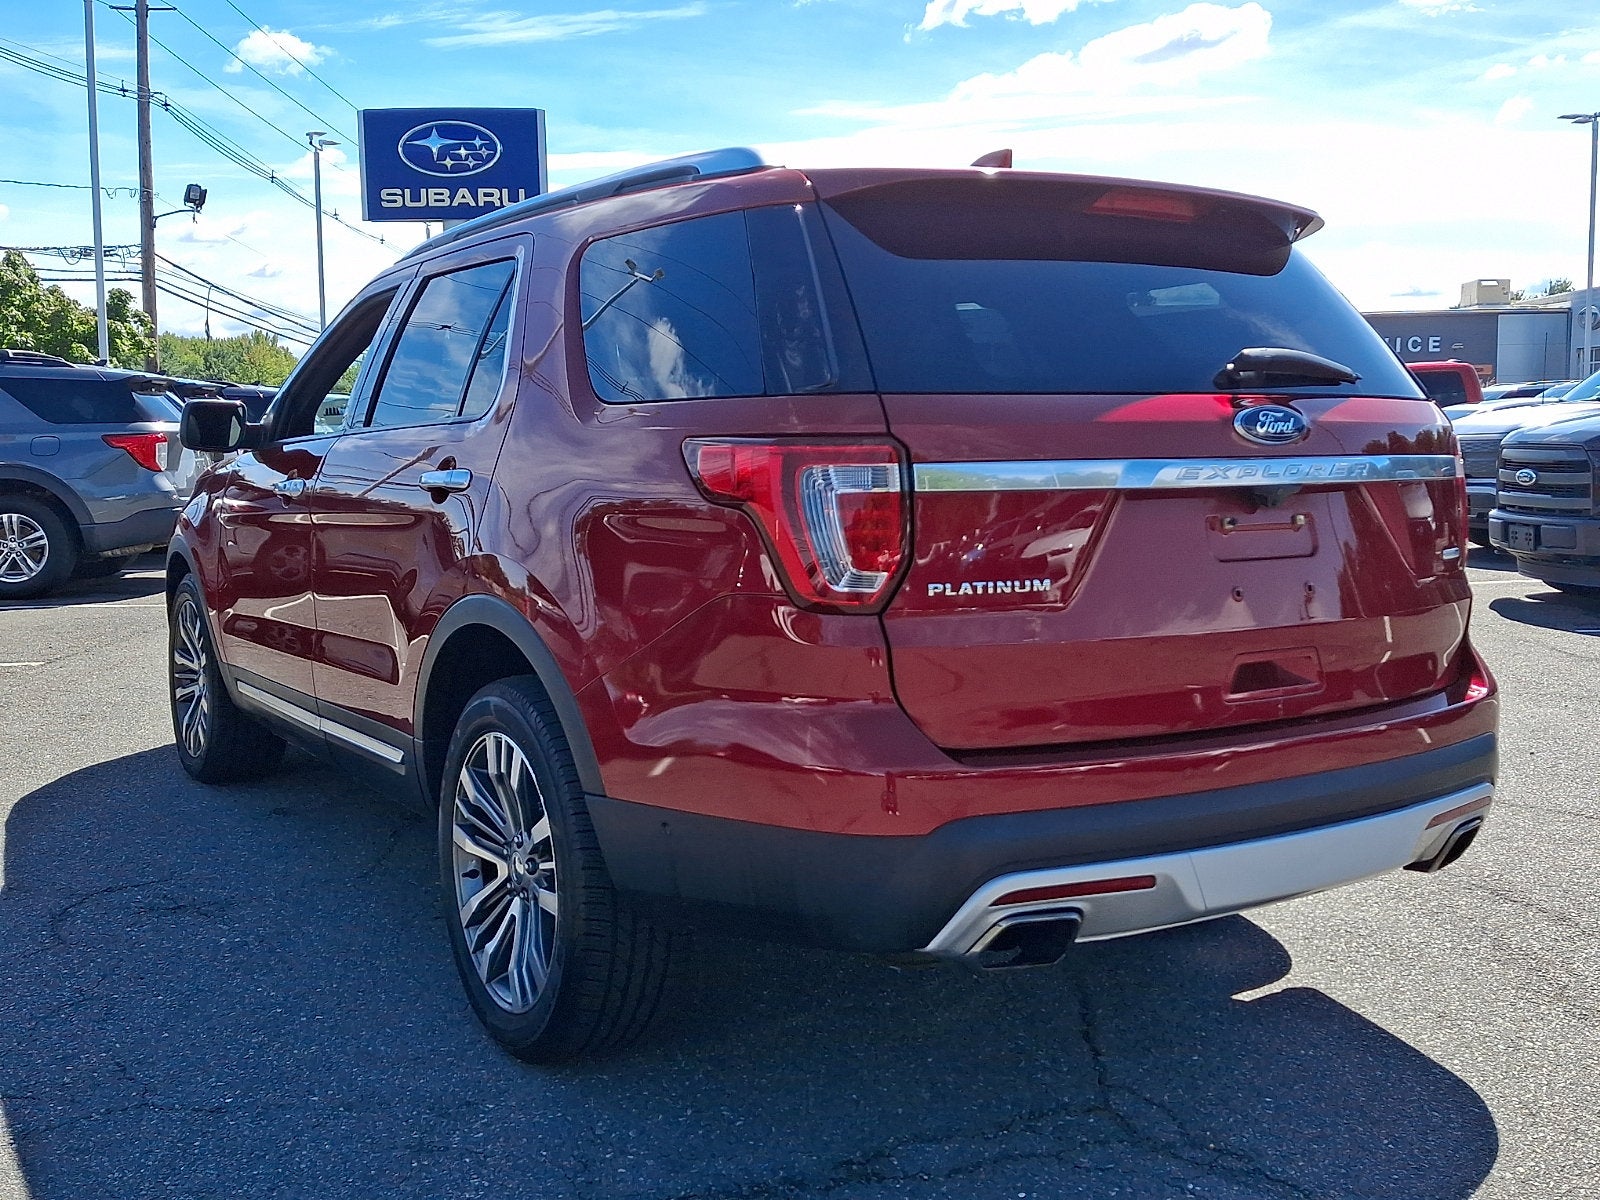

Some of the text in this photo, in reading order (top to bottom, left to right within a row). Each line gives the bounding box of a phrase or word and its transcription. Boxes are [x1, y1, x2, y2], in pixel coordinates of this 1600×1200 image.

[380, 188, 526, 208] SUBARU
[1256, 410, 1295, 434] Ford
[1175, 462, 1370, 481] EXPLORER
[927, 578, 1051, 597] PLATINUM
